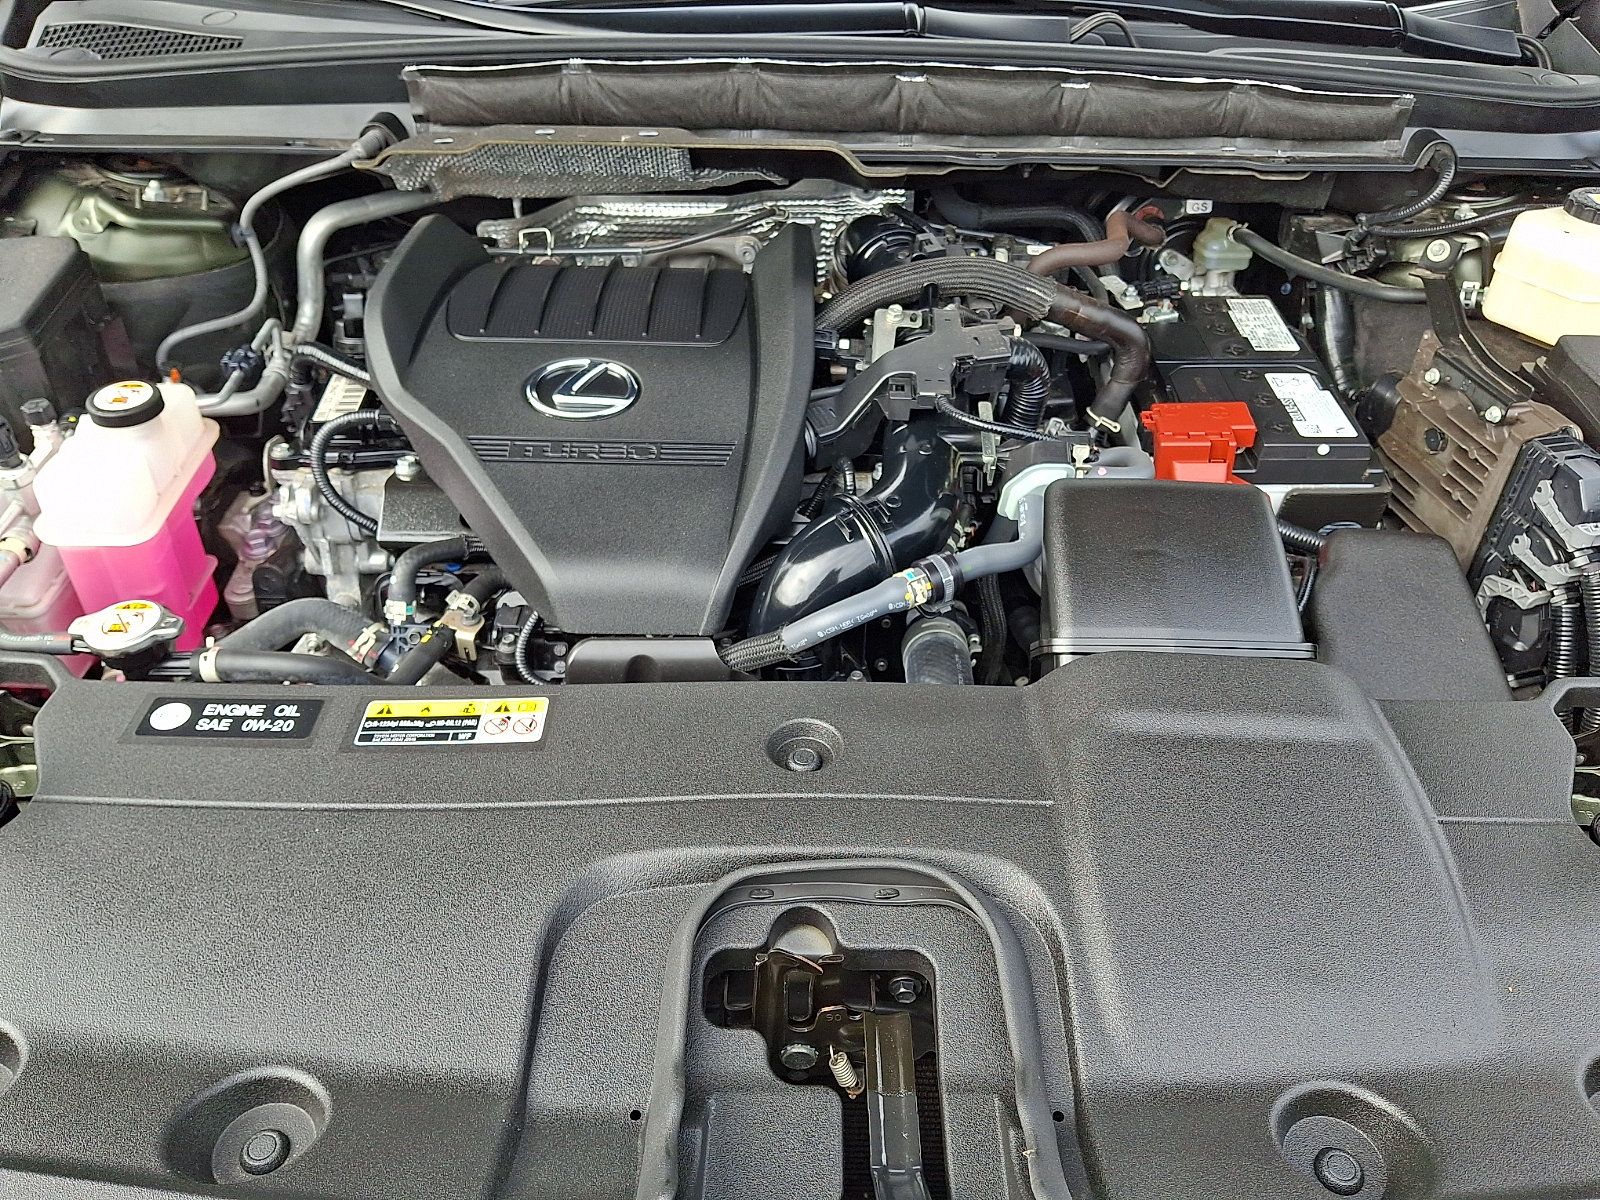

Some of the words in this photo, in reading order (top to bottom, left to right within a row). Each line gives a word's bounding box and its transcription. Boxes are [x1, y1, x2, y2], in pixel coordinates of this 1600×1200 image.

[1192, 202, 1208, 212] GS
[512, 441, 657, 460] TURBO
[202, 703, 267, 717] ENGINE
[273, 704, 301, 717] OIL
[195, 718, 234, 731] SAE
[241, 719, 295, 732] 0W-20
